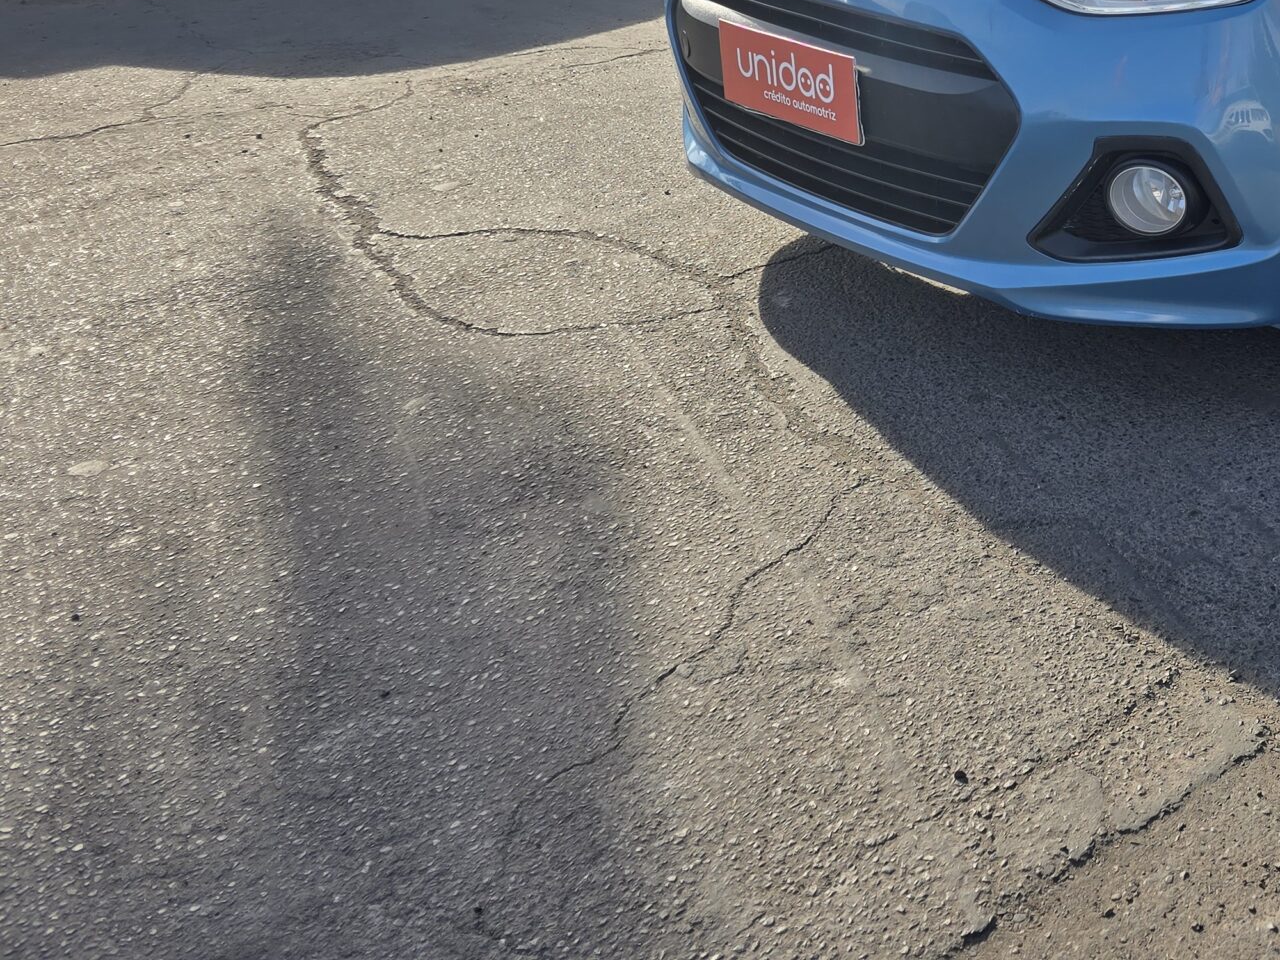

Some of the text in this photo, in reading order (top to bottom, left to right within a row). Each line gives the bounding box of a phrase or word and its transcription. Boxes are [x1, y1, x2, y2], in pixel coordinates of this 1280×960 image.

[736, 47, 835, 104] unidad
[763, 90, 837, 122] crédito automotriz
